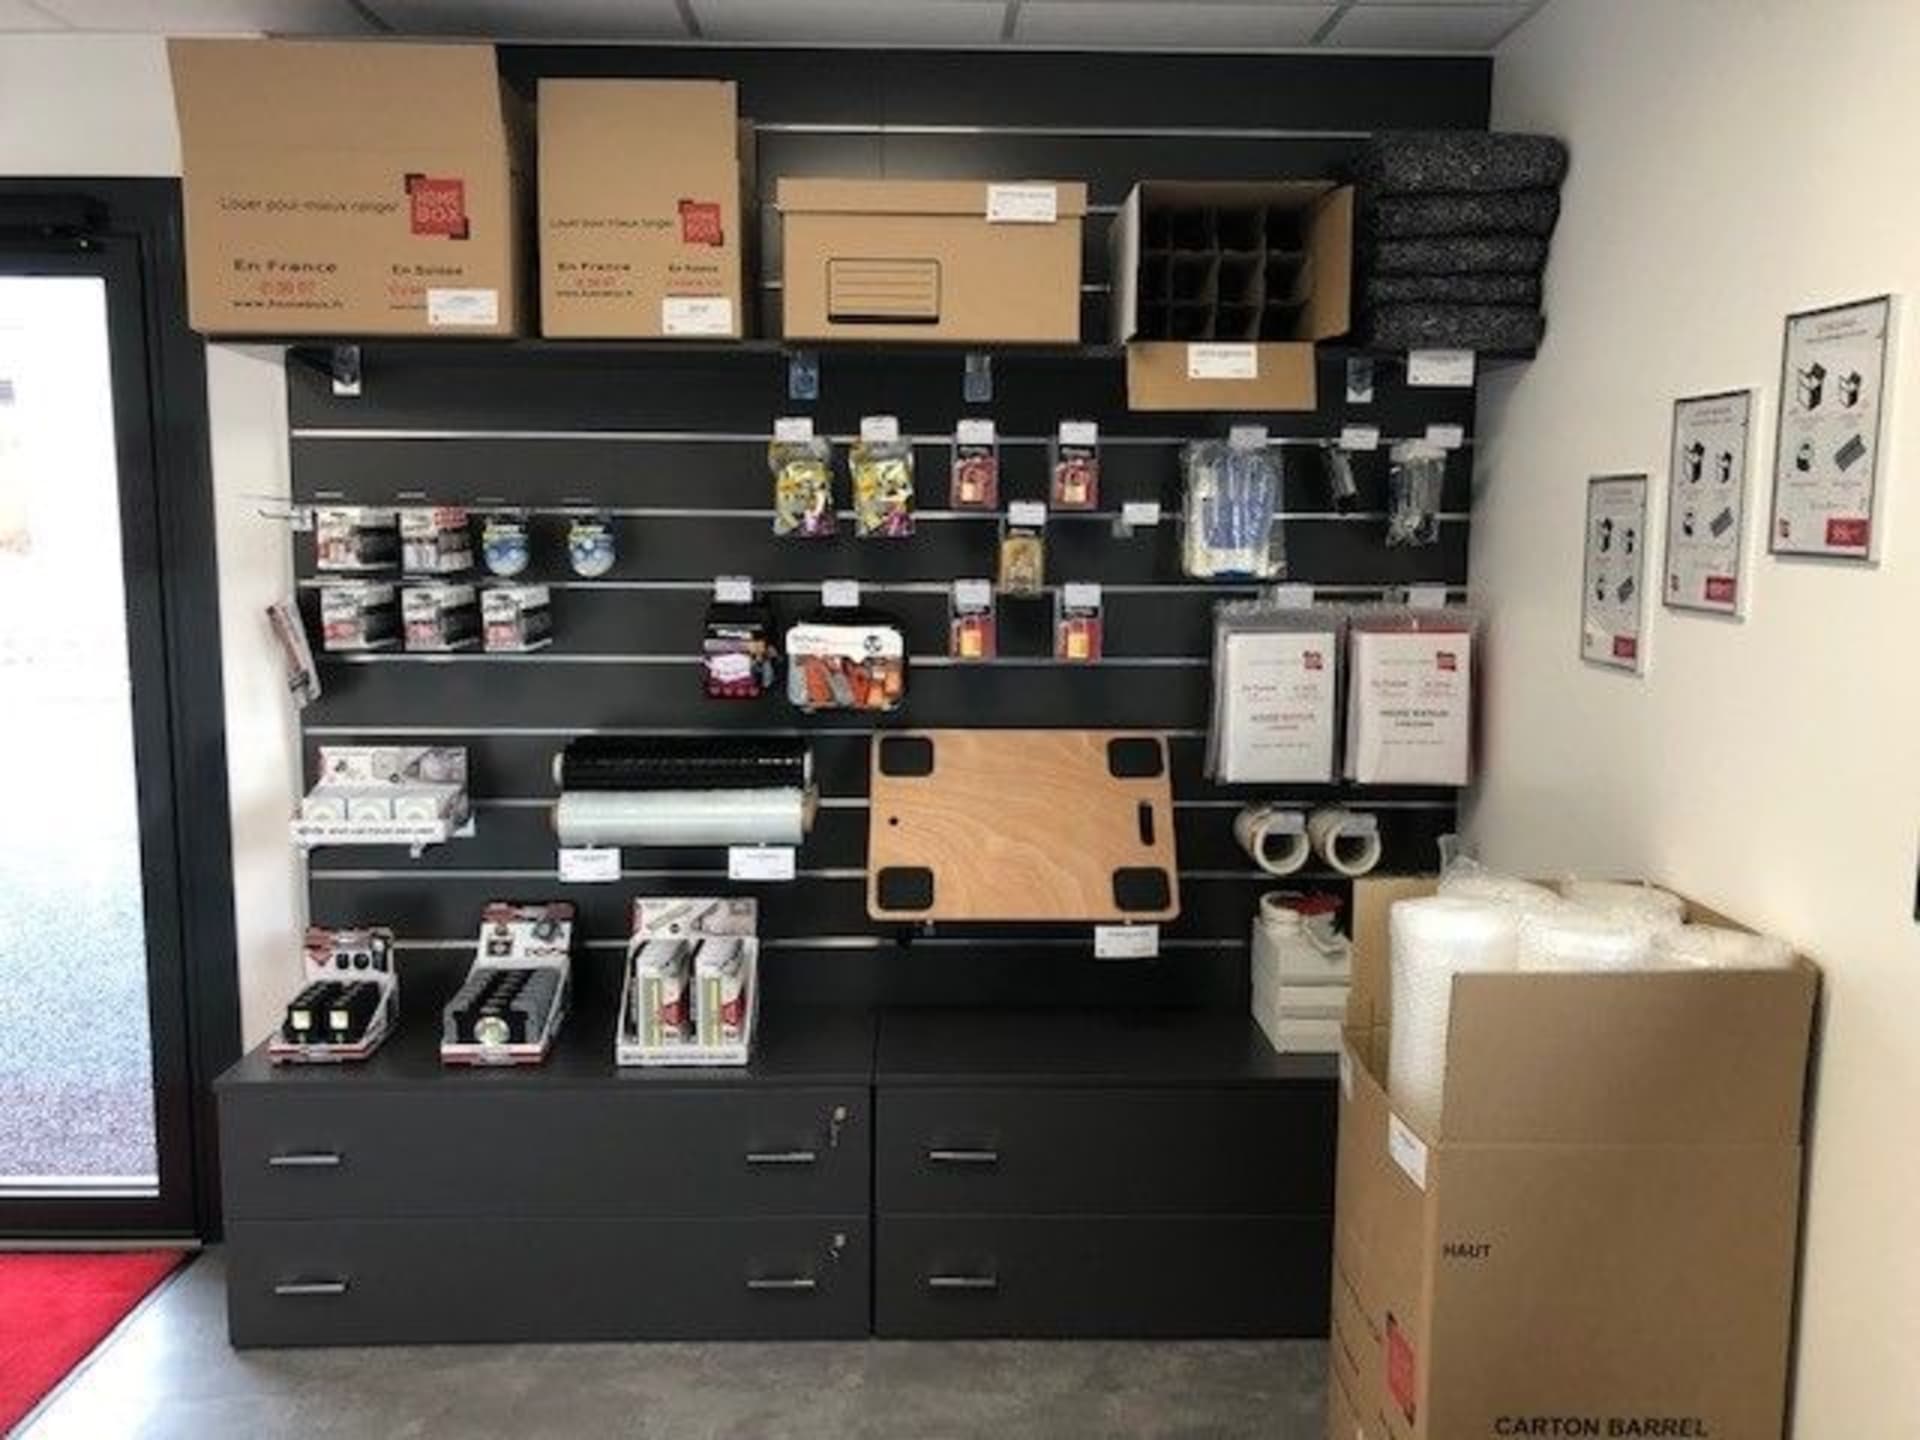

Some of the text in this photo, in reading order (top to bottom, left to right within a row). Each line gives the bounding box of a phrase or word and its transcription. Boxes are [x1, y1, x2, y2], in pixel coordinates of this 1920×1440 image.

[416, 206, 459, 223] BOX
[233, 258, 338, 274] En France
[391, 264, 412, 275] En
[557, 262, 632, 272] En France
[1442, 1243, 1492, 1259] HAUT
[1494, 1415, 1709, 1438] CARTON BARREL
